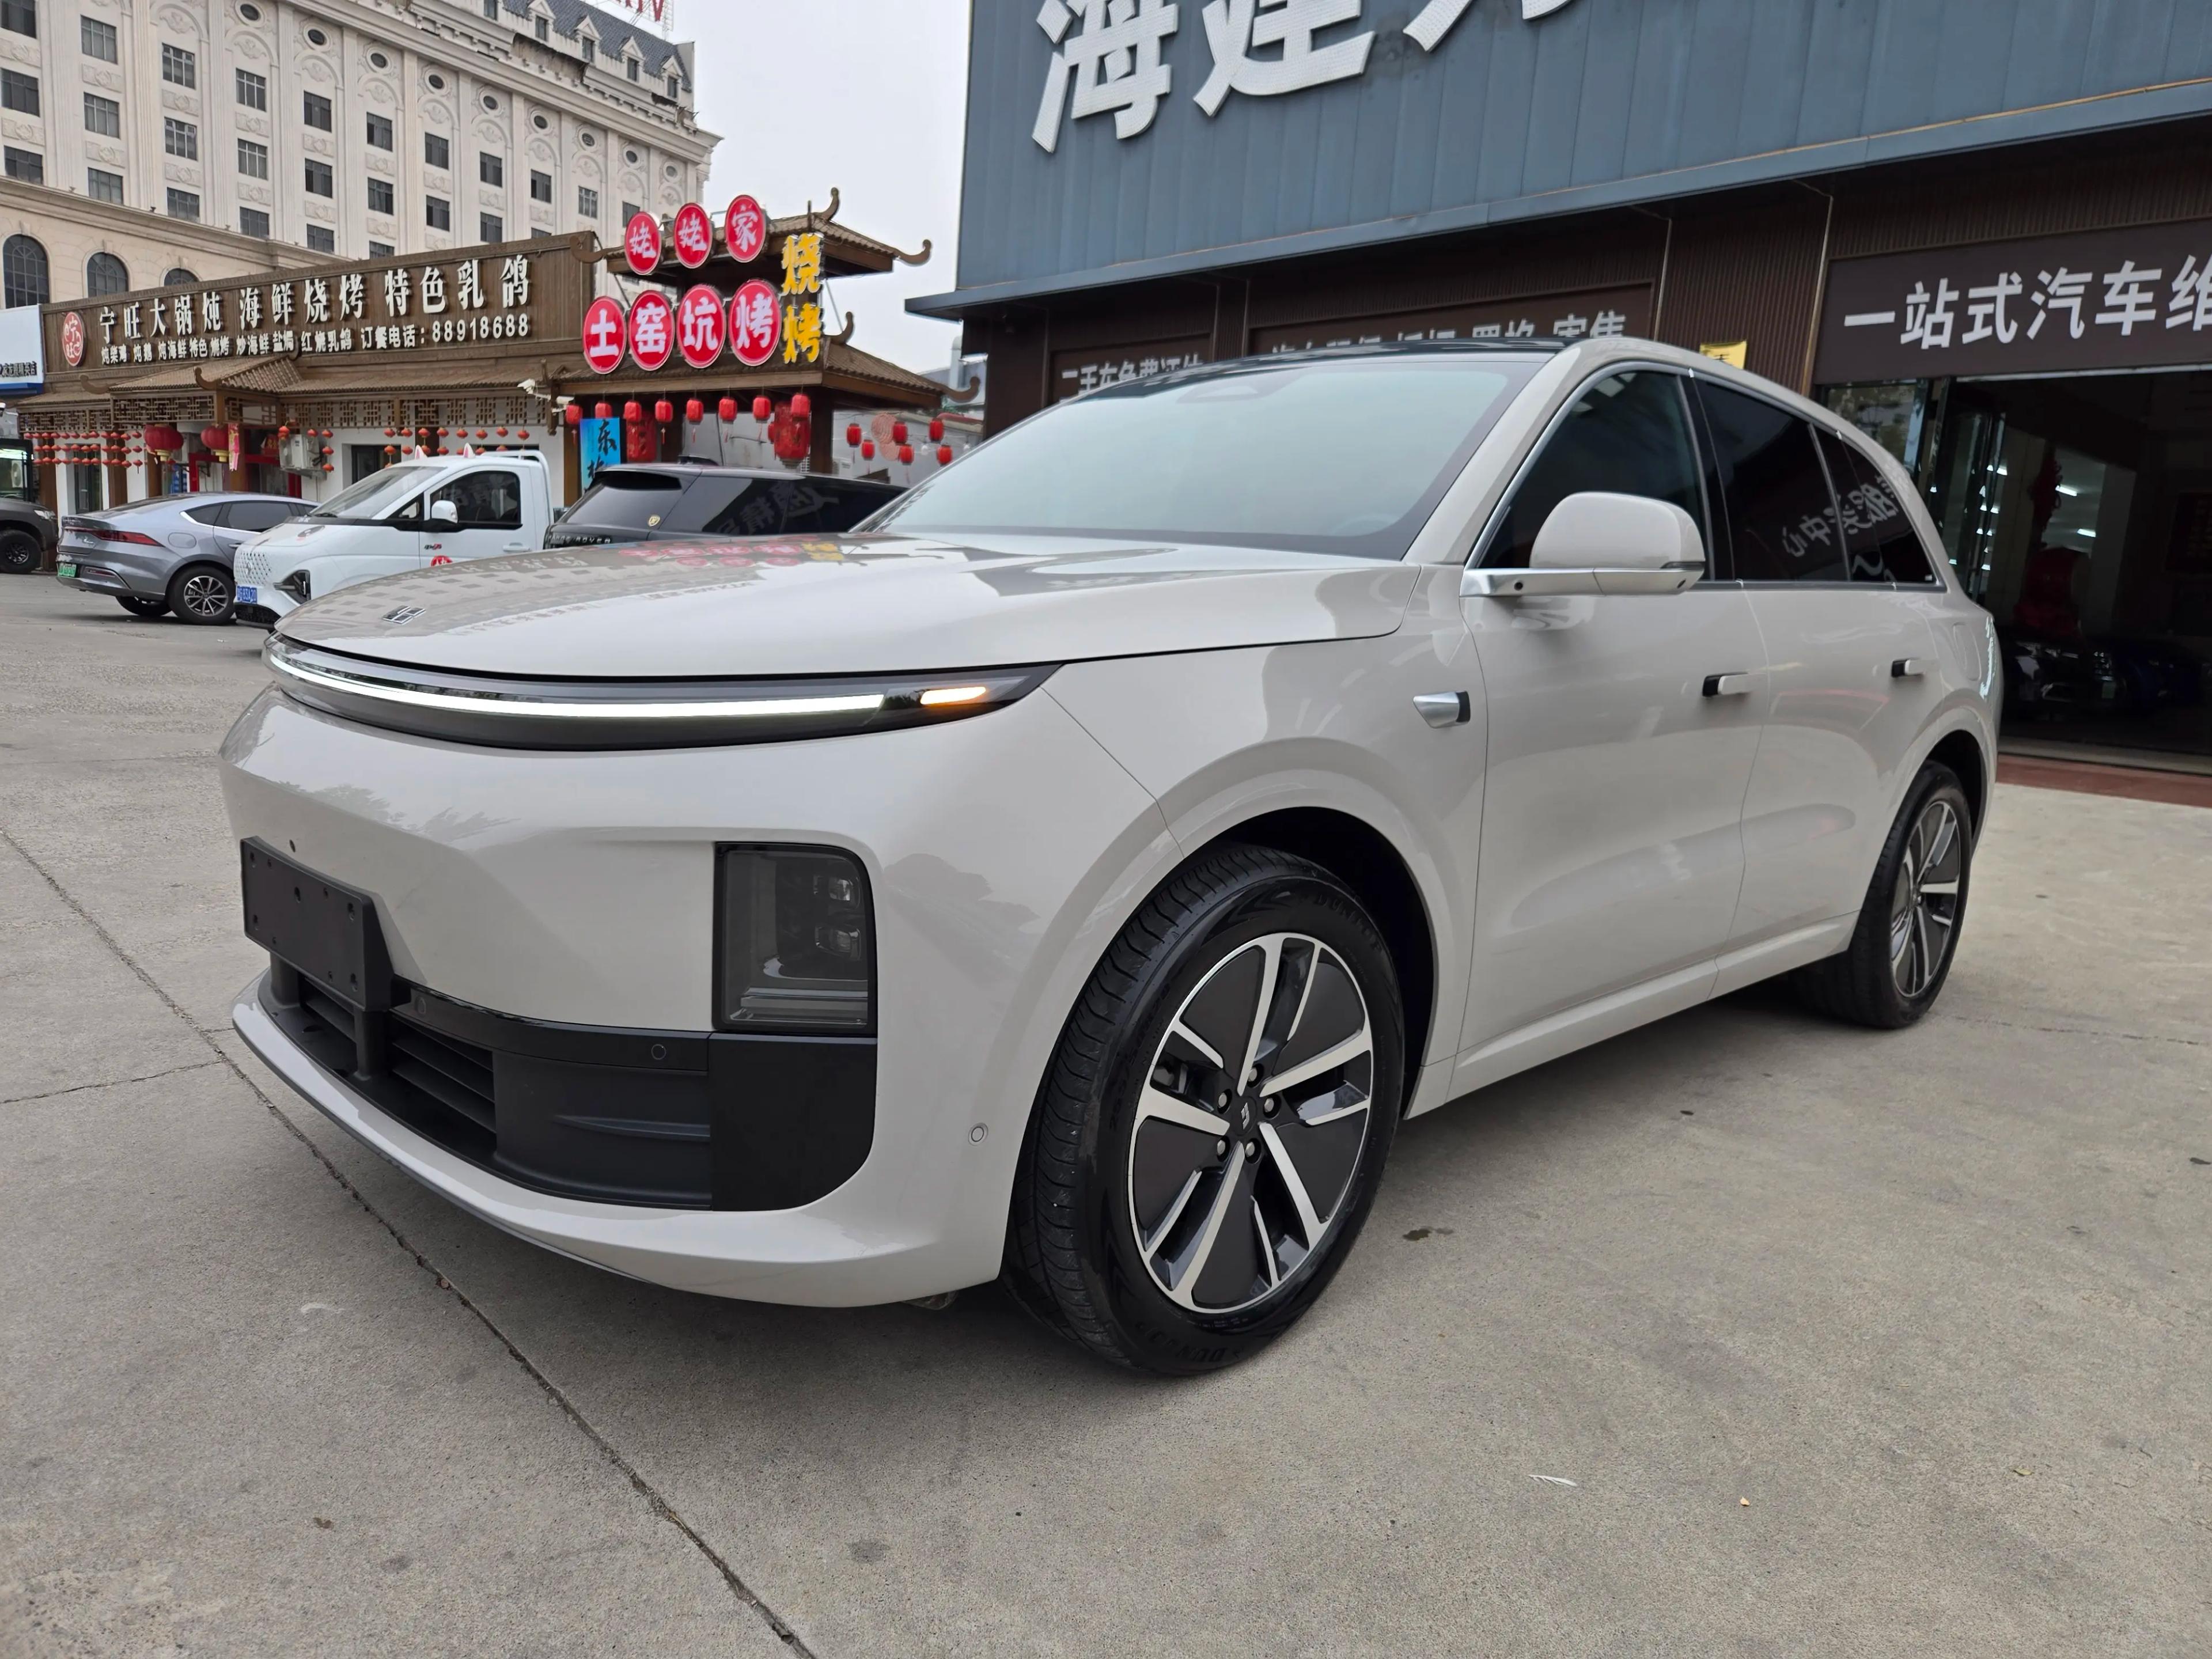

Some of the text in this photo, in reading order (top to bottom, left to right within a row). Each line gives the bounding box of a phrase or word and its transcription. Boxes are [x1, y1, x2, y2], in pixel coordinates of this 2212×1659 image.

[629, 204, 759, 260] 姥姥家
[589, 293, 774, 358] 土窑坑烤
[781, 233, 822, 364] 烧烤
